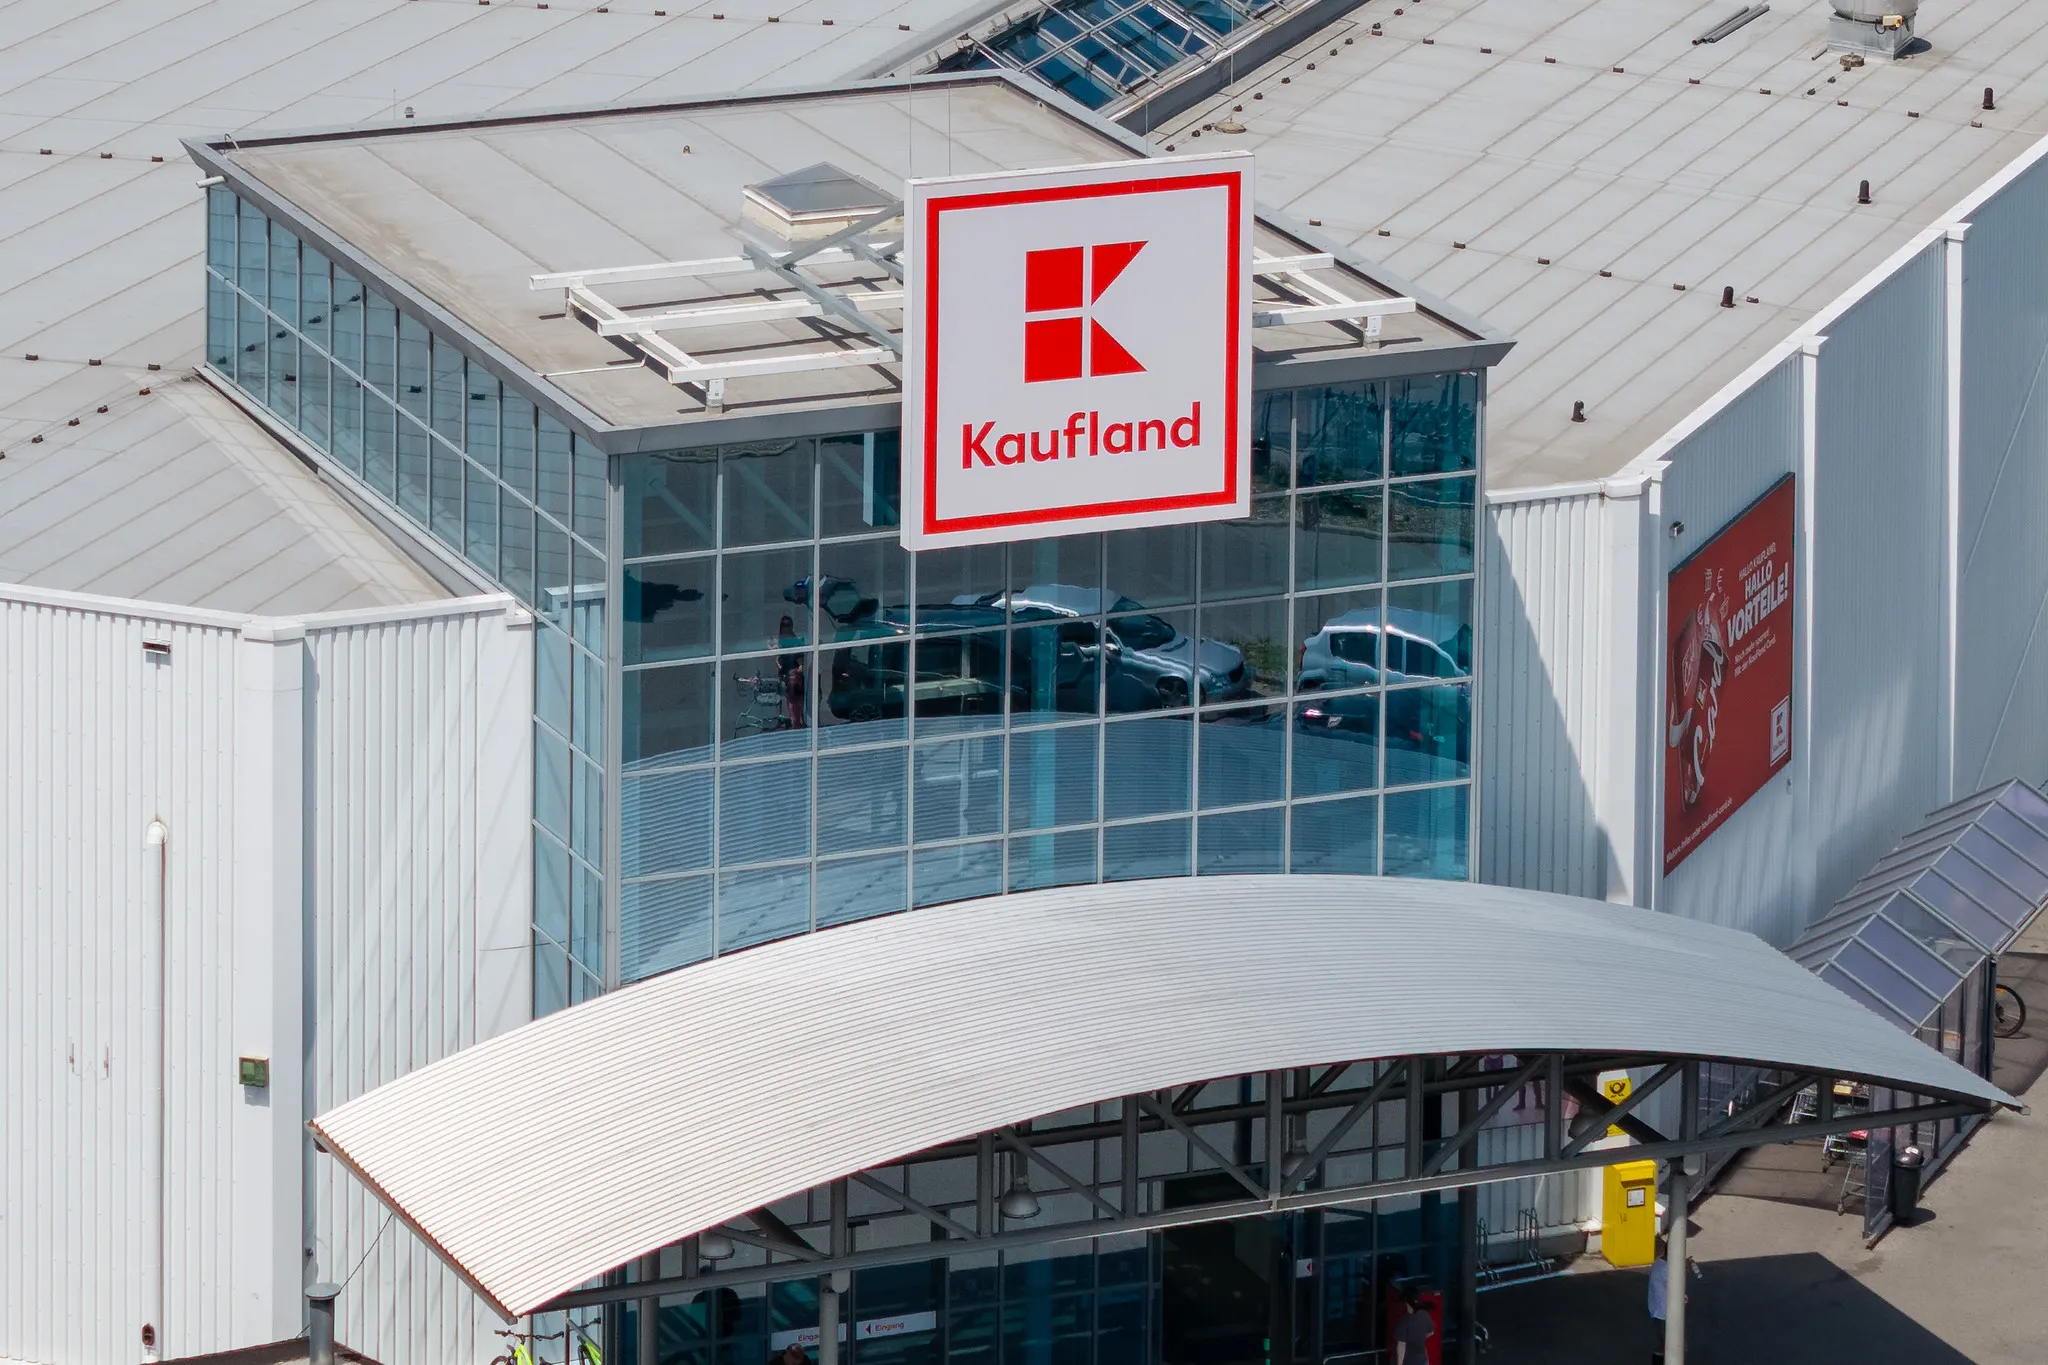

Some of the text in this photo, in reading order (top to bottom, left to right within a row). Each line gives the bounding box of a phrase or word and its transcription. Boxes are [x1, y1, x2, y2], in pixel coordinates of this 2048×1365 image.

[962, 401, 1201, 469] Kaufland
[1745, 559, 1773, 600] HALLO
[1727, 562, 1789, 648] VORTEILE!
[798, 1333, 820, 1343] Einga
[875, 1321, 905, 1333] Eingang
